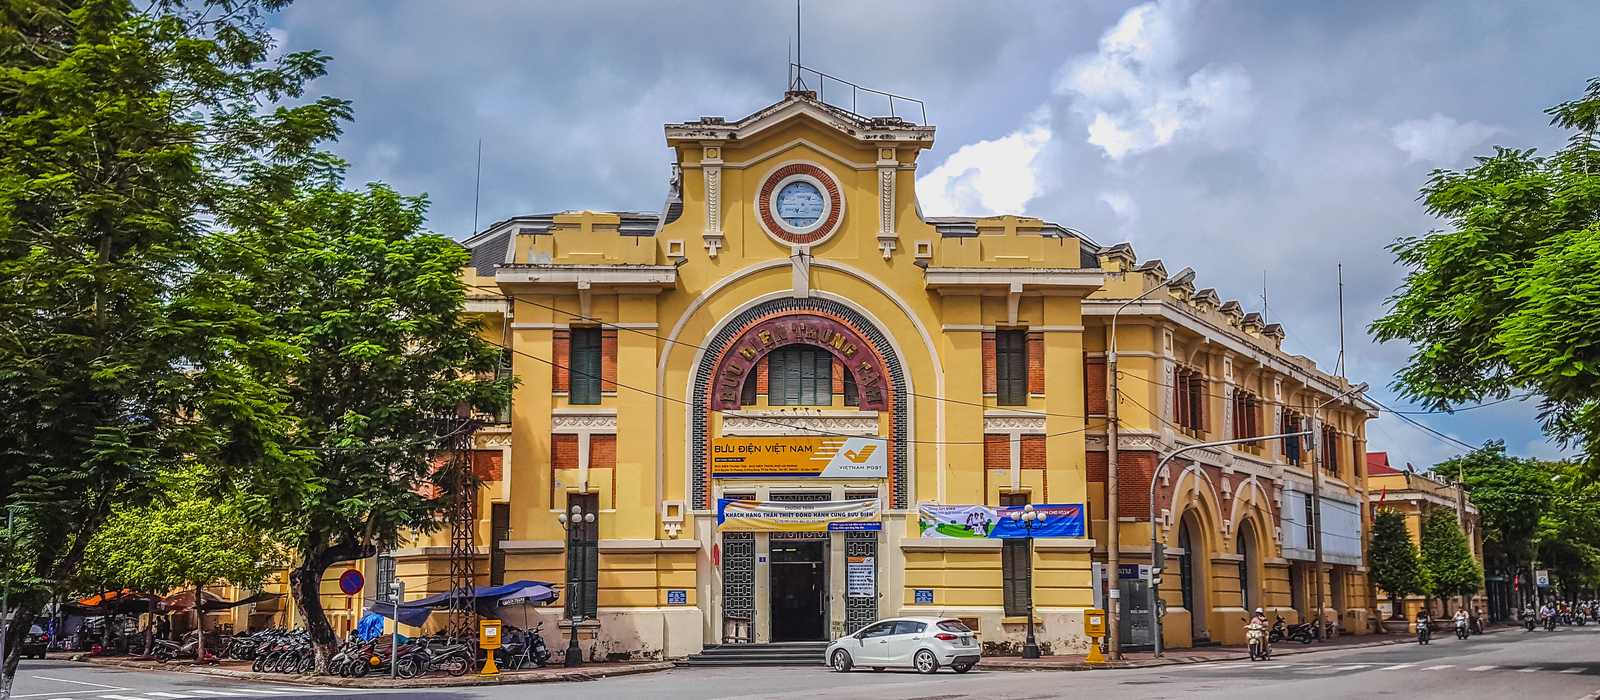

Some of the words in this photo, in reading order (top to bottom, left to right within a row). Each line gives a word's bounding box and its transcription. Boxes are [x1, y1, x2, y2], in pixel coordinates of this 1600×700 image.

[791, 322, 857, 358] TRUNG
[738, 442, 762, 455] ĐIỆN
[764, 442, 787, 455] VIỆT
[789, 445, 813, 453] NAM
